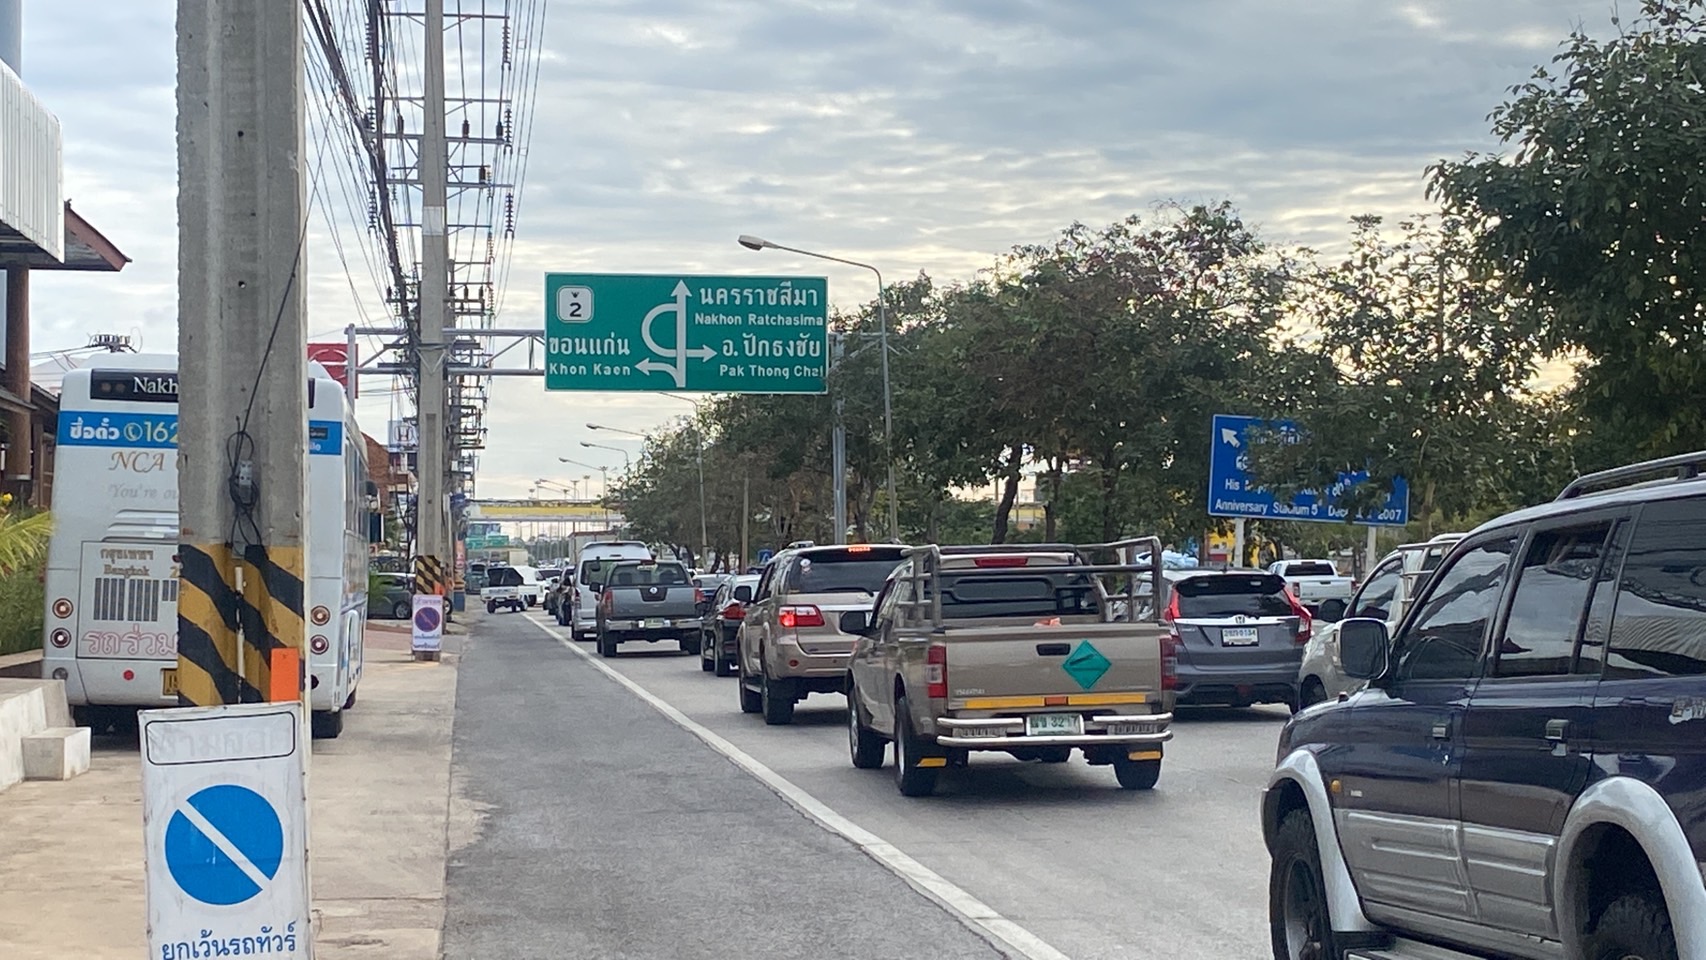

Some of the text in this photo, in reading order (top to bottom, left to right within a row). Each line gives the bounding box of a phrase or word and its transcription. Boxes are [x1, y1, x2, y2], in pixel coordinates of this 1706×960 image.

[700, 281, 818, 306] นครราชสีมา
[569, 302, 582, 318] 2
[694, 312, 824, 326] Nakhon Ratchasima
[549, 331, 631, 355] ขอนแก่น
[722, 332, 820, 357] อ. ปักธงชัย
[549, 362, 631, 375] Khon Kaen
[720, 364, 823, 379] Pak Thong Chai
[108, 451, 166, 473] NCA
[1225, 478, 1240, 490] His
[1215, 499, 1268, 515] Anniversary
[104, 564, 150, 578] Bangkok
[162, 920, 296, 960] ยกเว้นรถทัวร์
